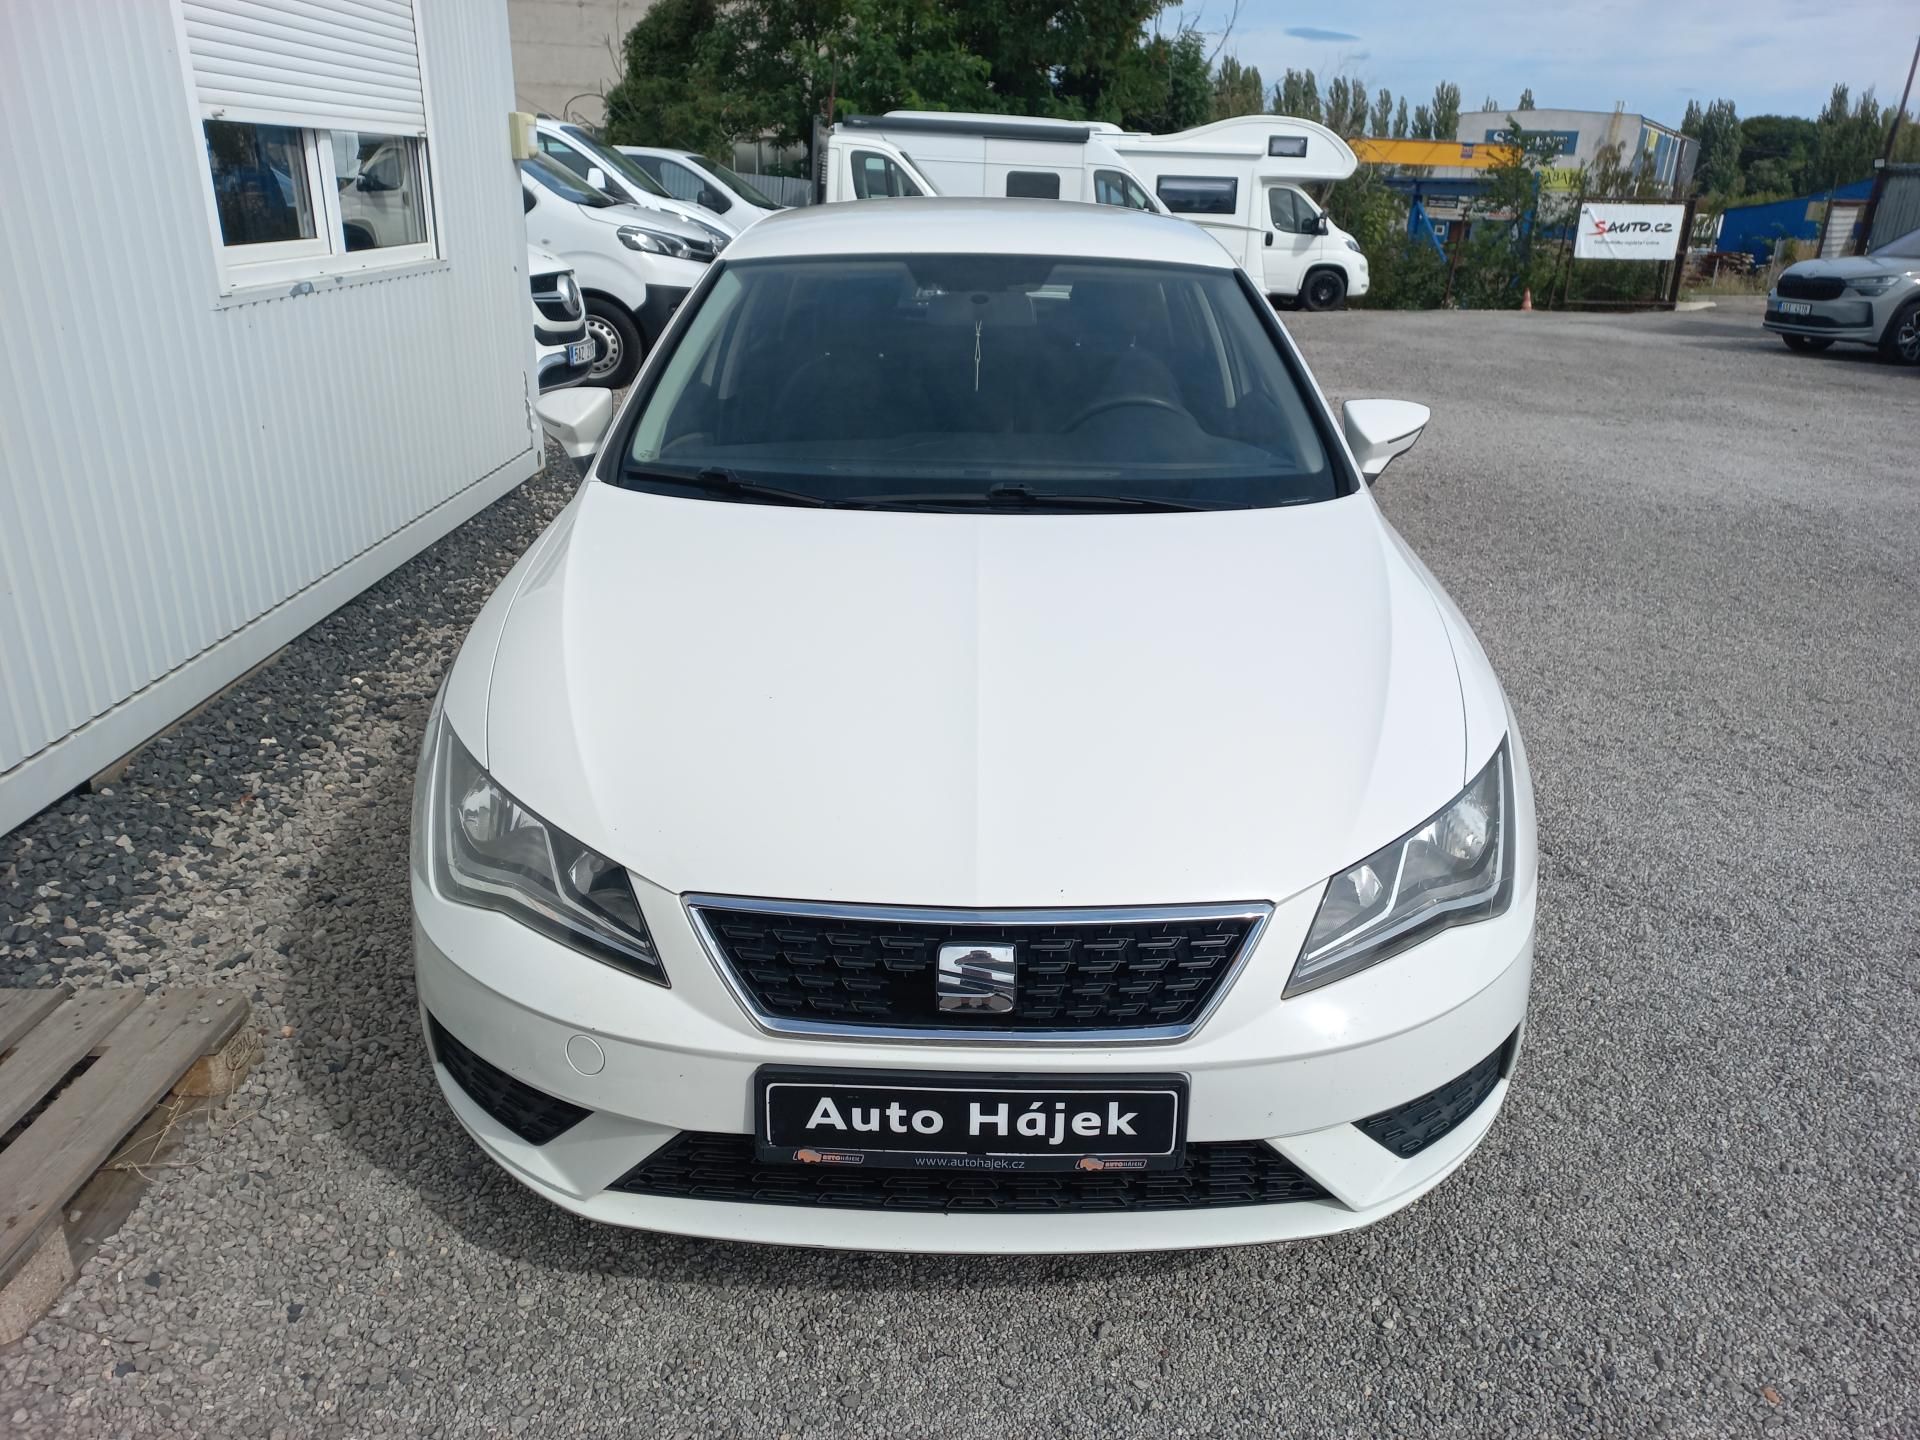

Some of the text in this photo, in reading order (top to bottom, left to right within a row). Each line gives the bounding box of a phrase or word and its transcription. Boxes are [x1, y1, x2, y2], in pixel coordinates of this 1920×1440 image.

[805, 1096, 1139, 1144] Auto Hájek
[914, 1157, 1026, 1171] www.autohajek.cz
